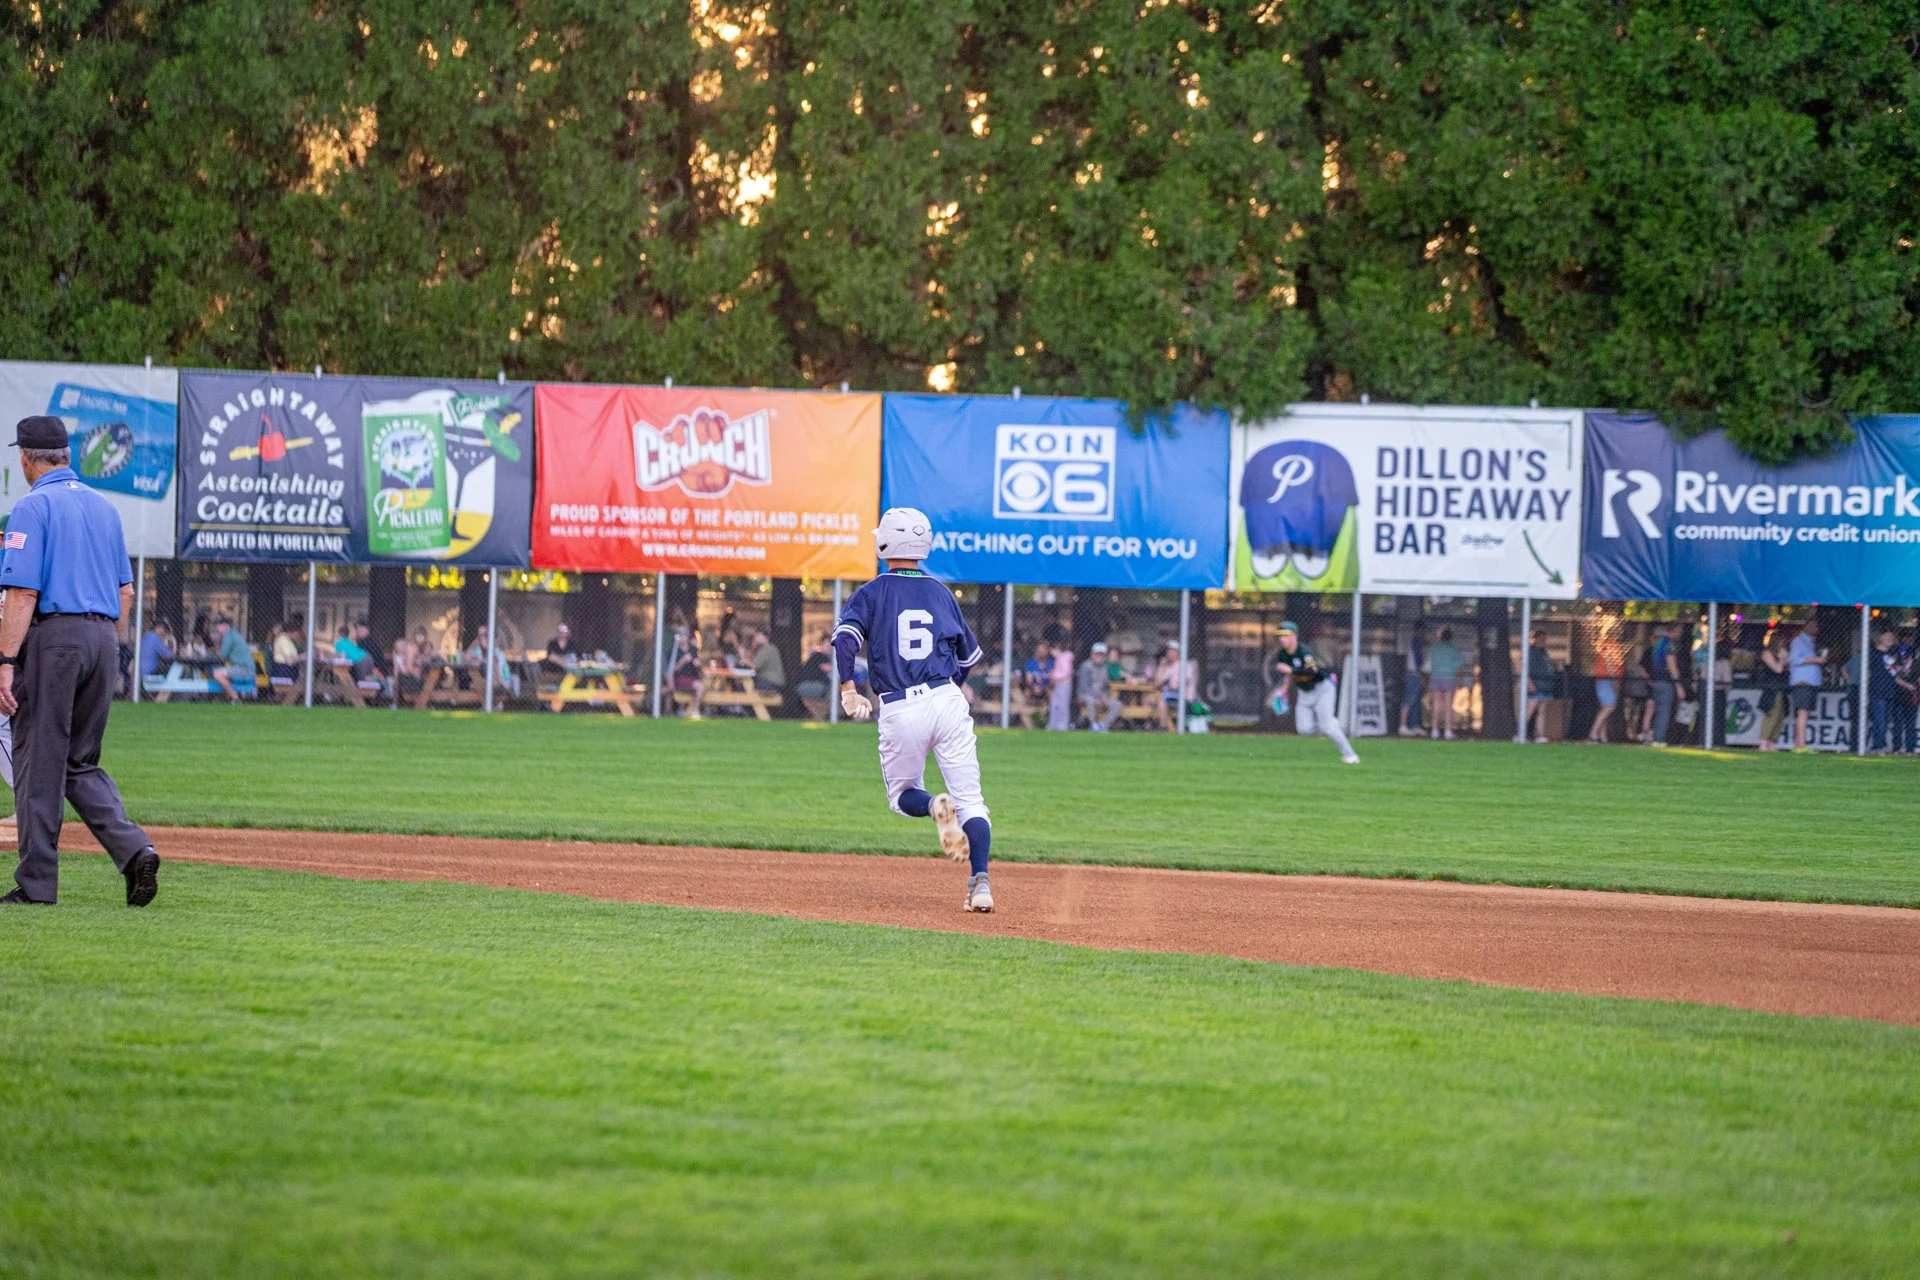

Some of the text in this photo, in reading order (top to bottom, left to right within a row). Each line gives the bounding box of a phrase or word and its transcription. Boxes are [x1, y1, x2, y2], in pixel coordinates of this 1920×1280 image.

[200, 387, 344, 469] STRAIGHTAWAY
[1009, 431, 1104, 455] KOIN
[636, 409, 771, 488] CRUNCH
[1376, 446, 1548, 483] DILLON'S
[198, 471, 345, 500] Astonishing
[1051, 461, 1108, 516] 6
[1267, 454, 1315, 504] P
[1674, 469, 1920, 518] Rivermark
[197, 495, 344, 525] Cocktails
[550, 503, 860, 531] PROUD SPONSOR OF THE PORTLAND PICKLES
[1375, 485, 1572, 522] HIDEAWAY
[196, 531, 343, 553] CRAFTED IN PORTLAND
[931, 531, 1198, 560] ATCHING OUT FOR YOU
[1374, 522, 1447, 555] BAR
[1674, 521, 1920, 546] community credit union
[897, 608, 934, 662] 6
